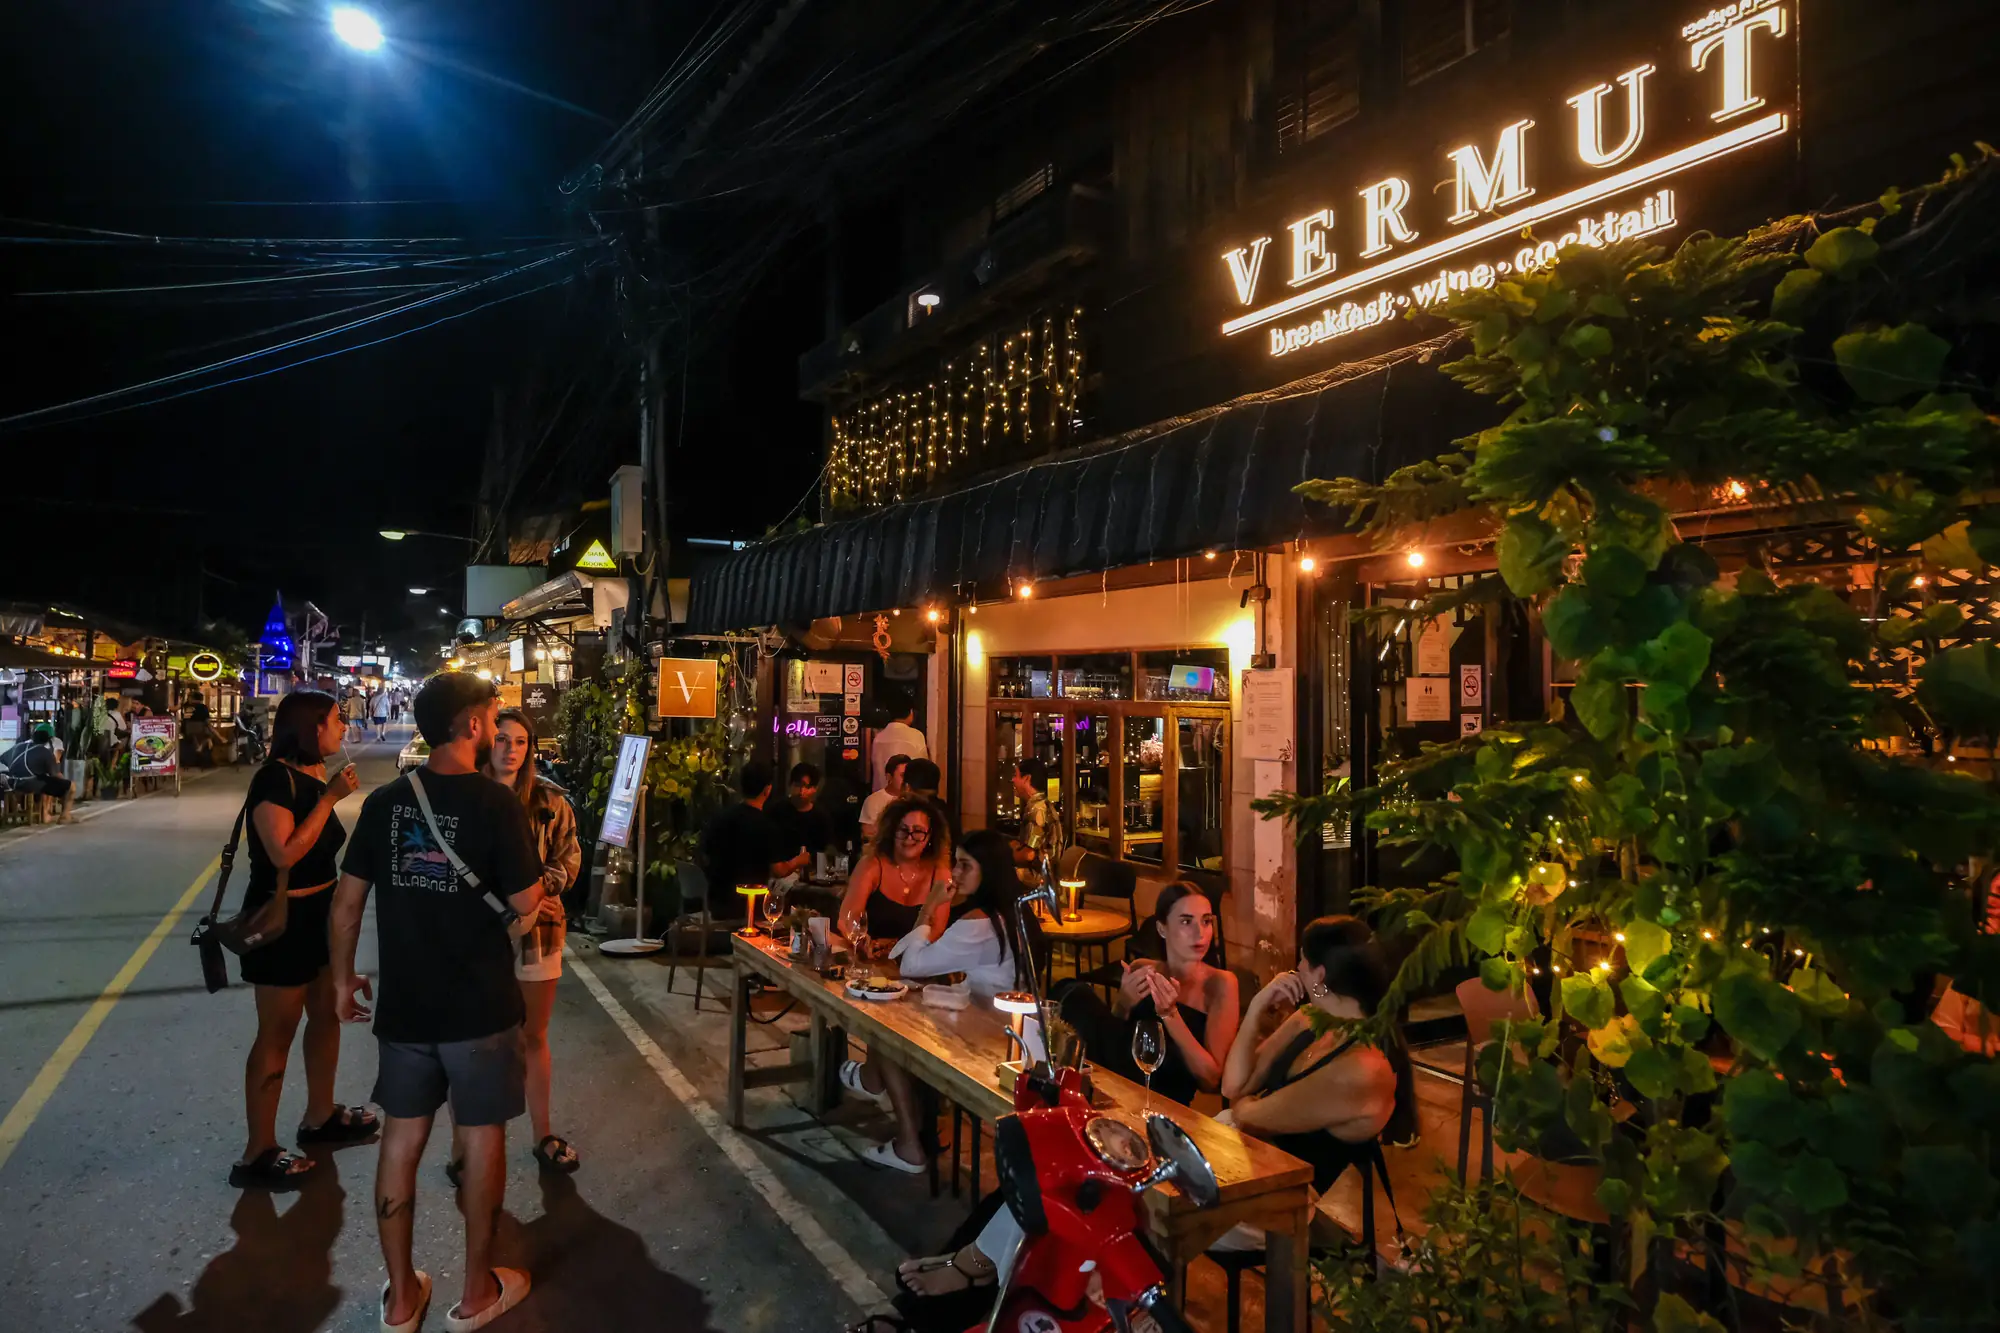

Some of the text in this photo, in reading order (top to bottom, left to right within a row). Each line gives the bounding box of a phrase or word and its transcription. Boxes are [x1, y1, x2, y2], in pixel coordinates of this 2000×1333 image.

[1221, 5, 1788, 307] VERMUT
[1270, 291, 1395, 356] breakfast
[1412, 263, 1495, 310] wine
